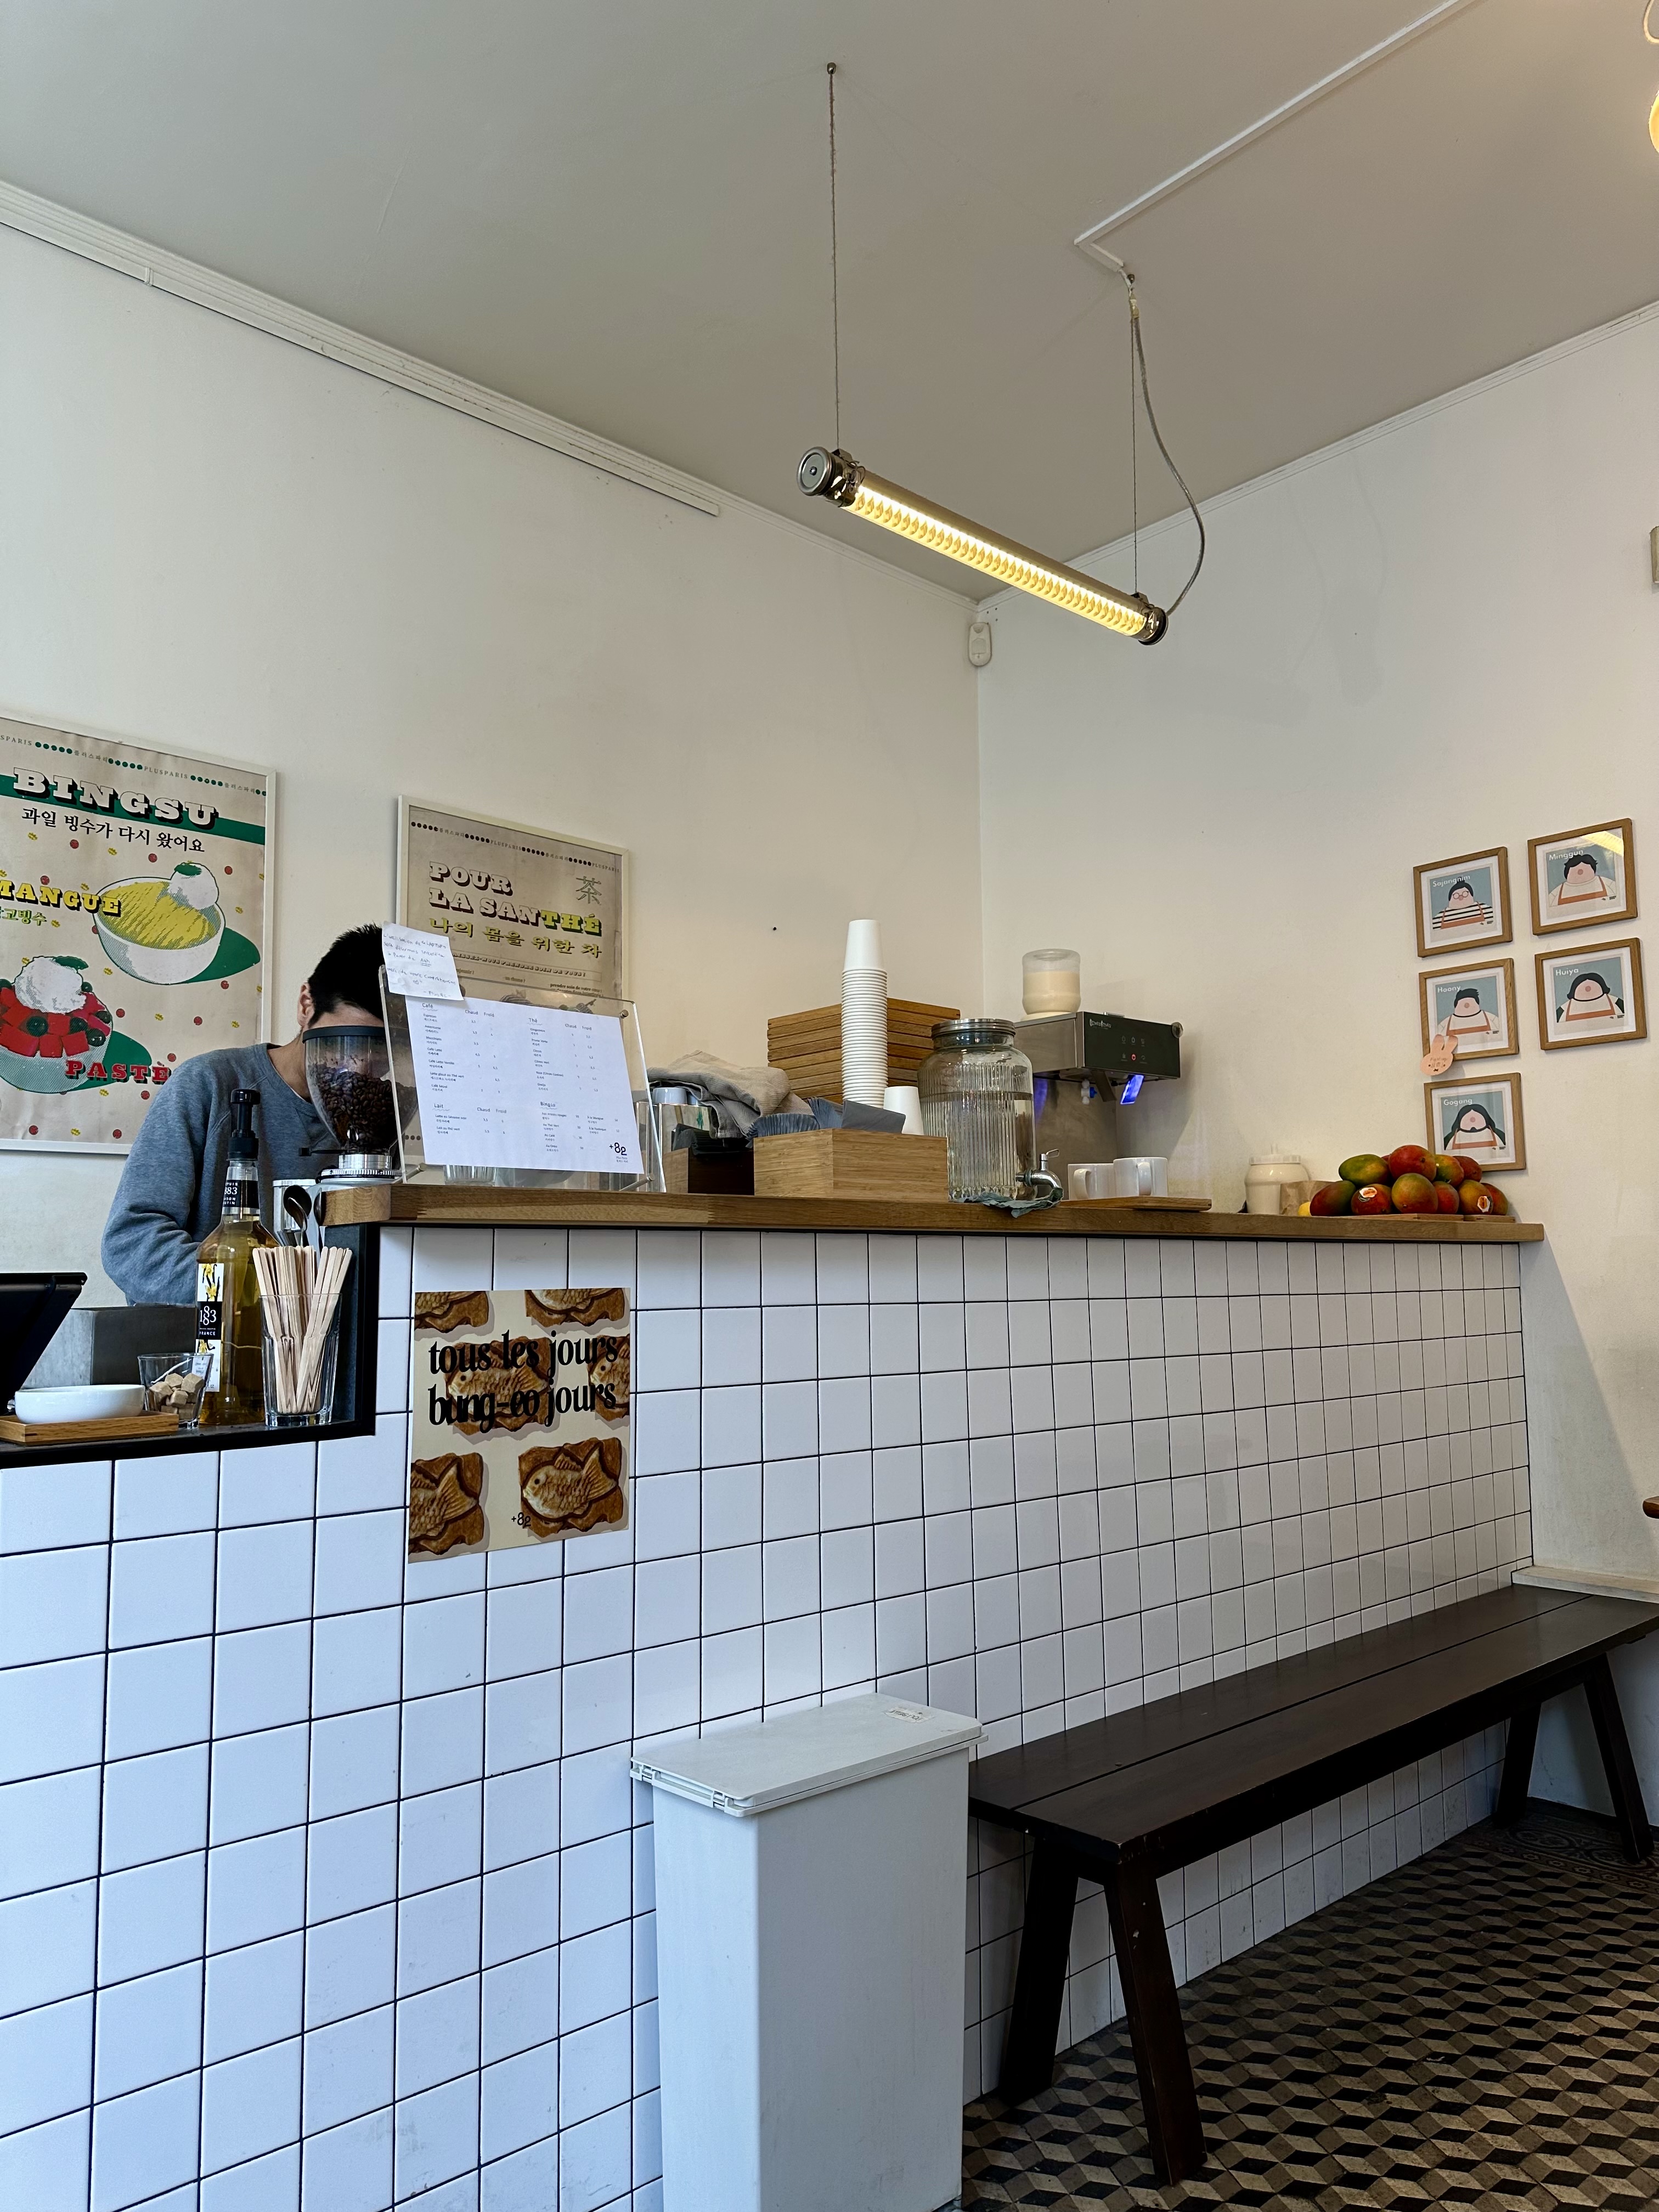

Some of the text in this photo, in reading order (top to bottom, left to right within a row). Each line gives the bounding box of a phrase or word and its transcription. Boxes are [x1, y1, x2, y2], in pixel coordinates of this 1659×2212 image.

[144, 766, 188, 779] PLUSPARIS
[13, 767, 219, 830] BINGSU
[22, 808, 205, 853] 과일 빙수가 다시 왔어요
[1549, 850, 1583, 861] Minggun
[429, 861, 513, 896] POUR
[575, 876, 602, 905] 茶
[1432, 875, 1470, 887] Sajangnim
[429, 887, 602, 936] LA SANTHÉ
[429, 917, 602, 958] 나의 몸을 위한 차
[452, 952, 500, 964] AISSEZ-NOUS
[1555, 968, 1579, 976] Huiya
[65, 1060, 171, 1085] PASTÈ
[609, 1142, 627, 1155] +82
[428, 1329, 618, 1378] tous les jours
[545, 1379, 617, 1426] jours
[511, 1512, 532, 1528] +82
